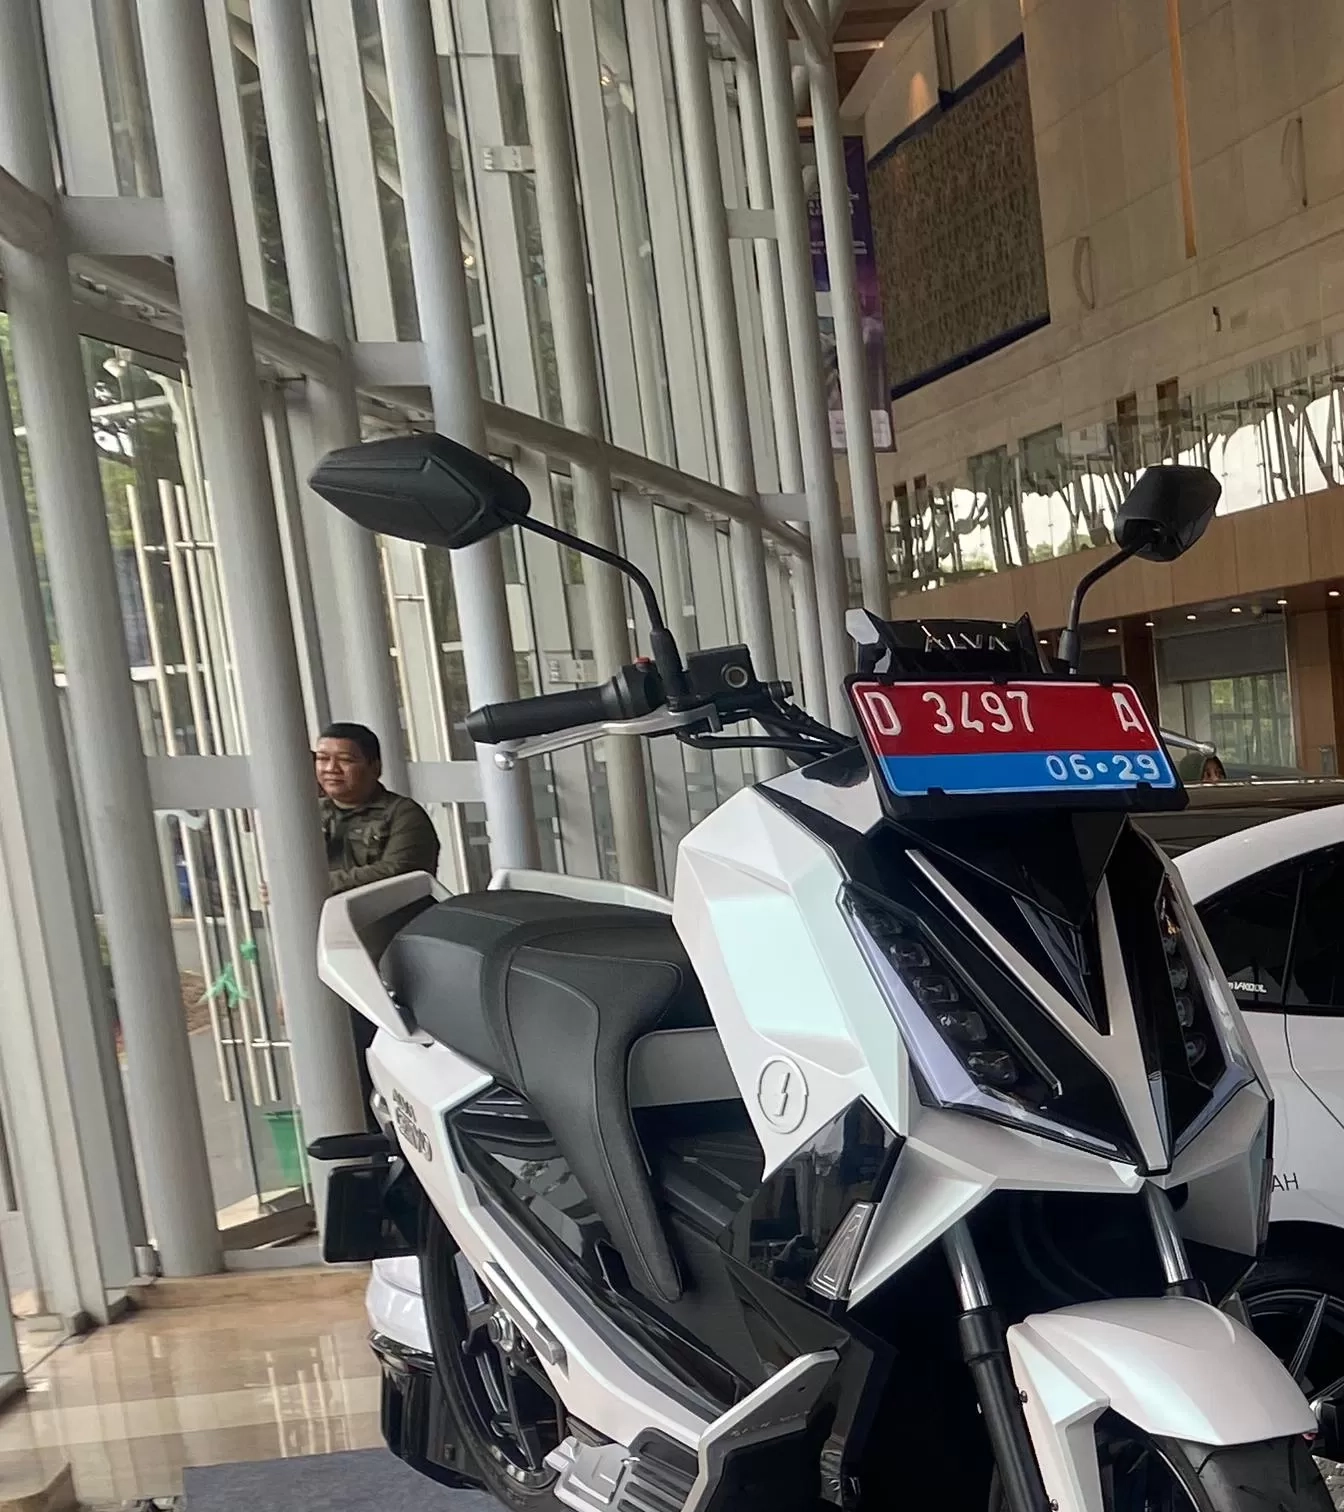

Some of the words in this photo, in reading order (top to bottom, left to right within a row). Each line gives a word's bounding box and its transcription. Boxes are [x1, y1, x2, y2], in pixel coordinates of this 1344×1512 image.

[864, 691, 901, 736] D
[922, 690, 1034, 734] 3497
[1111, 691, 1144, 732] A
